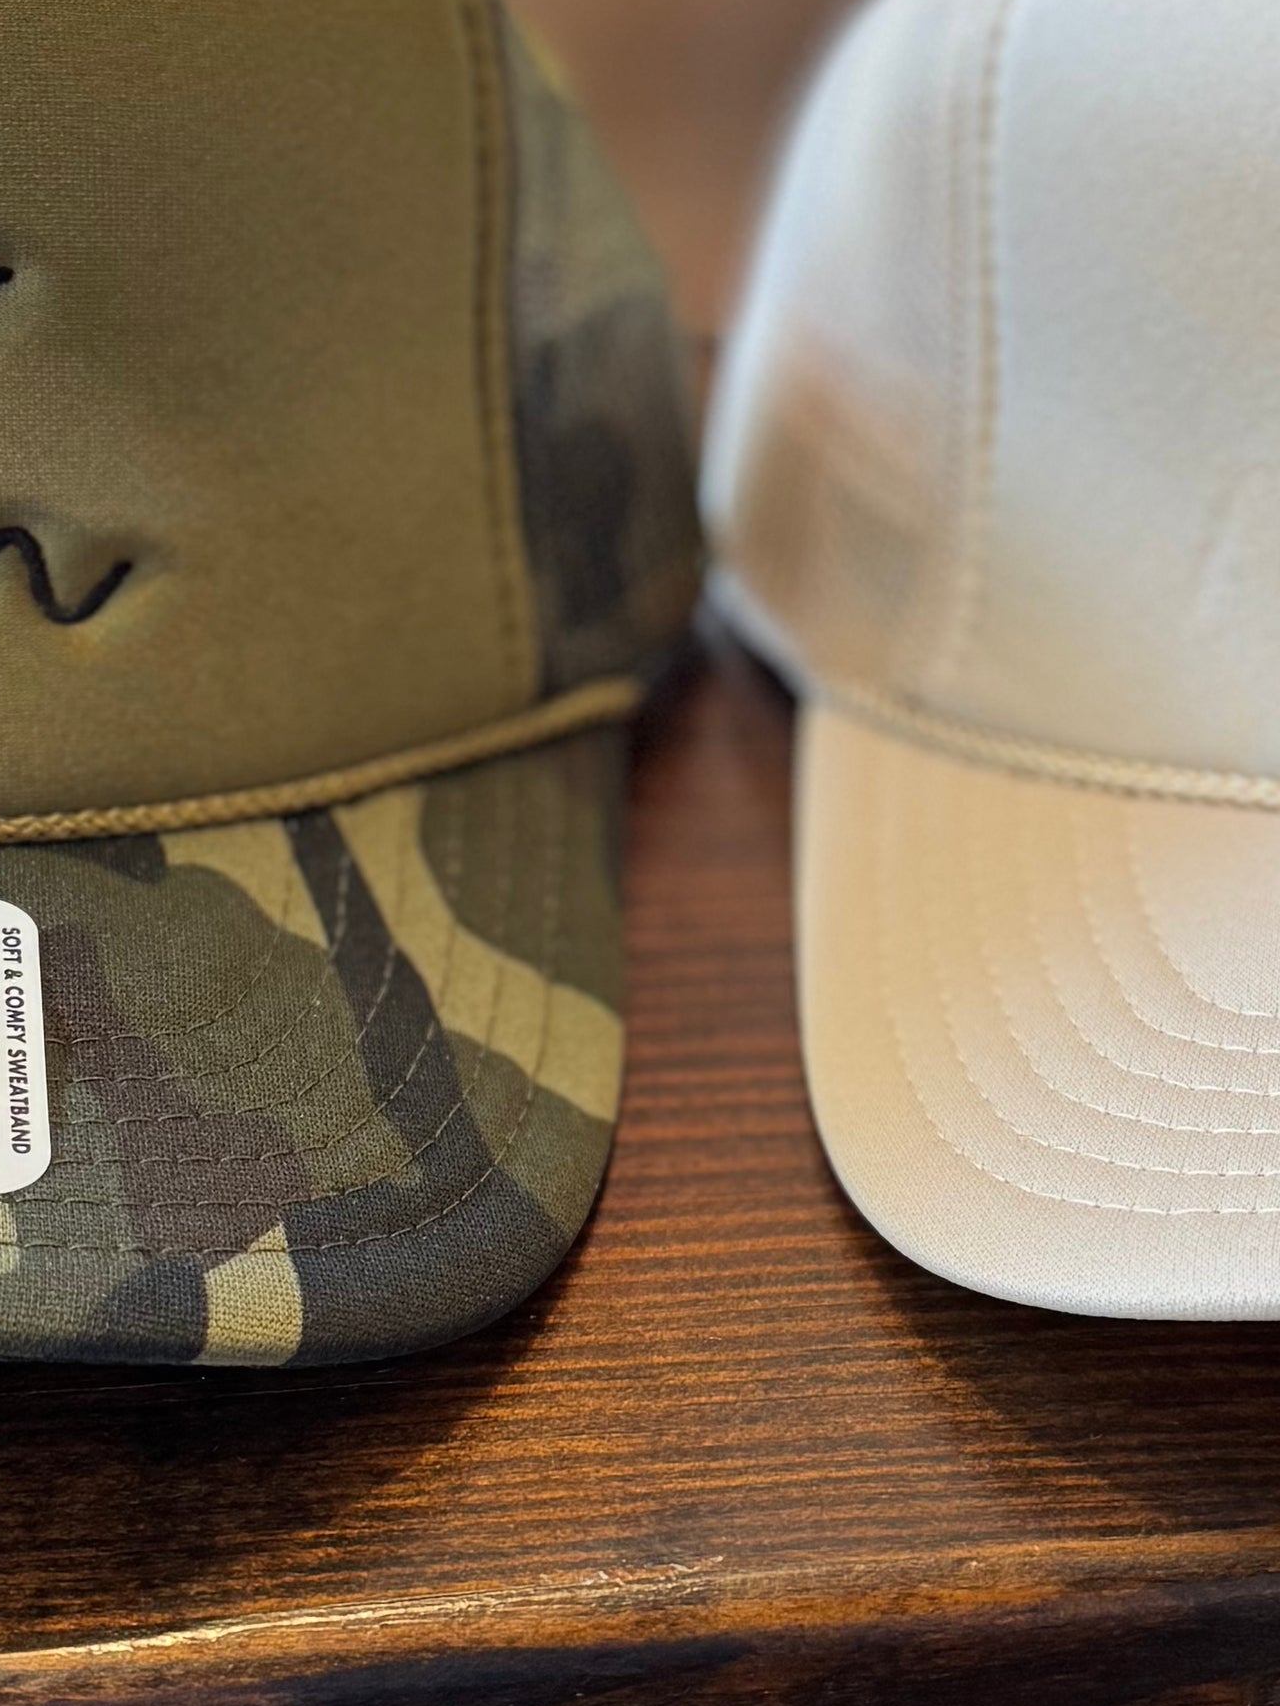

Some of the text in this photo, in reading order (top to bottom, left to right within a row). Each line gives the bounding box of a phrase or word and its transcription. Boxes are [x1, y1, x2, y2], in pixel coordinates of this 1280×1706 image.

[2, 927, 31, 1156] SOFT & COMFY SWEATBAND
